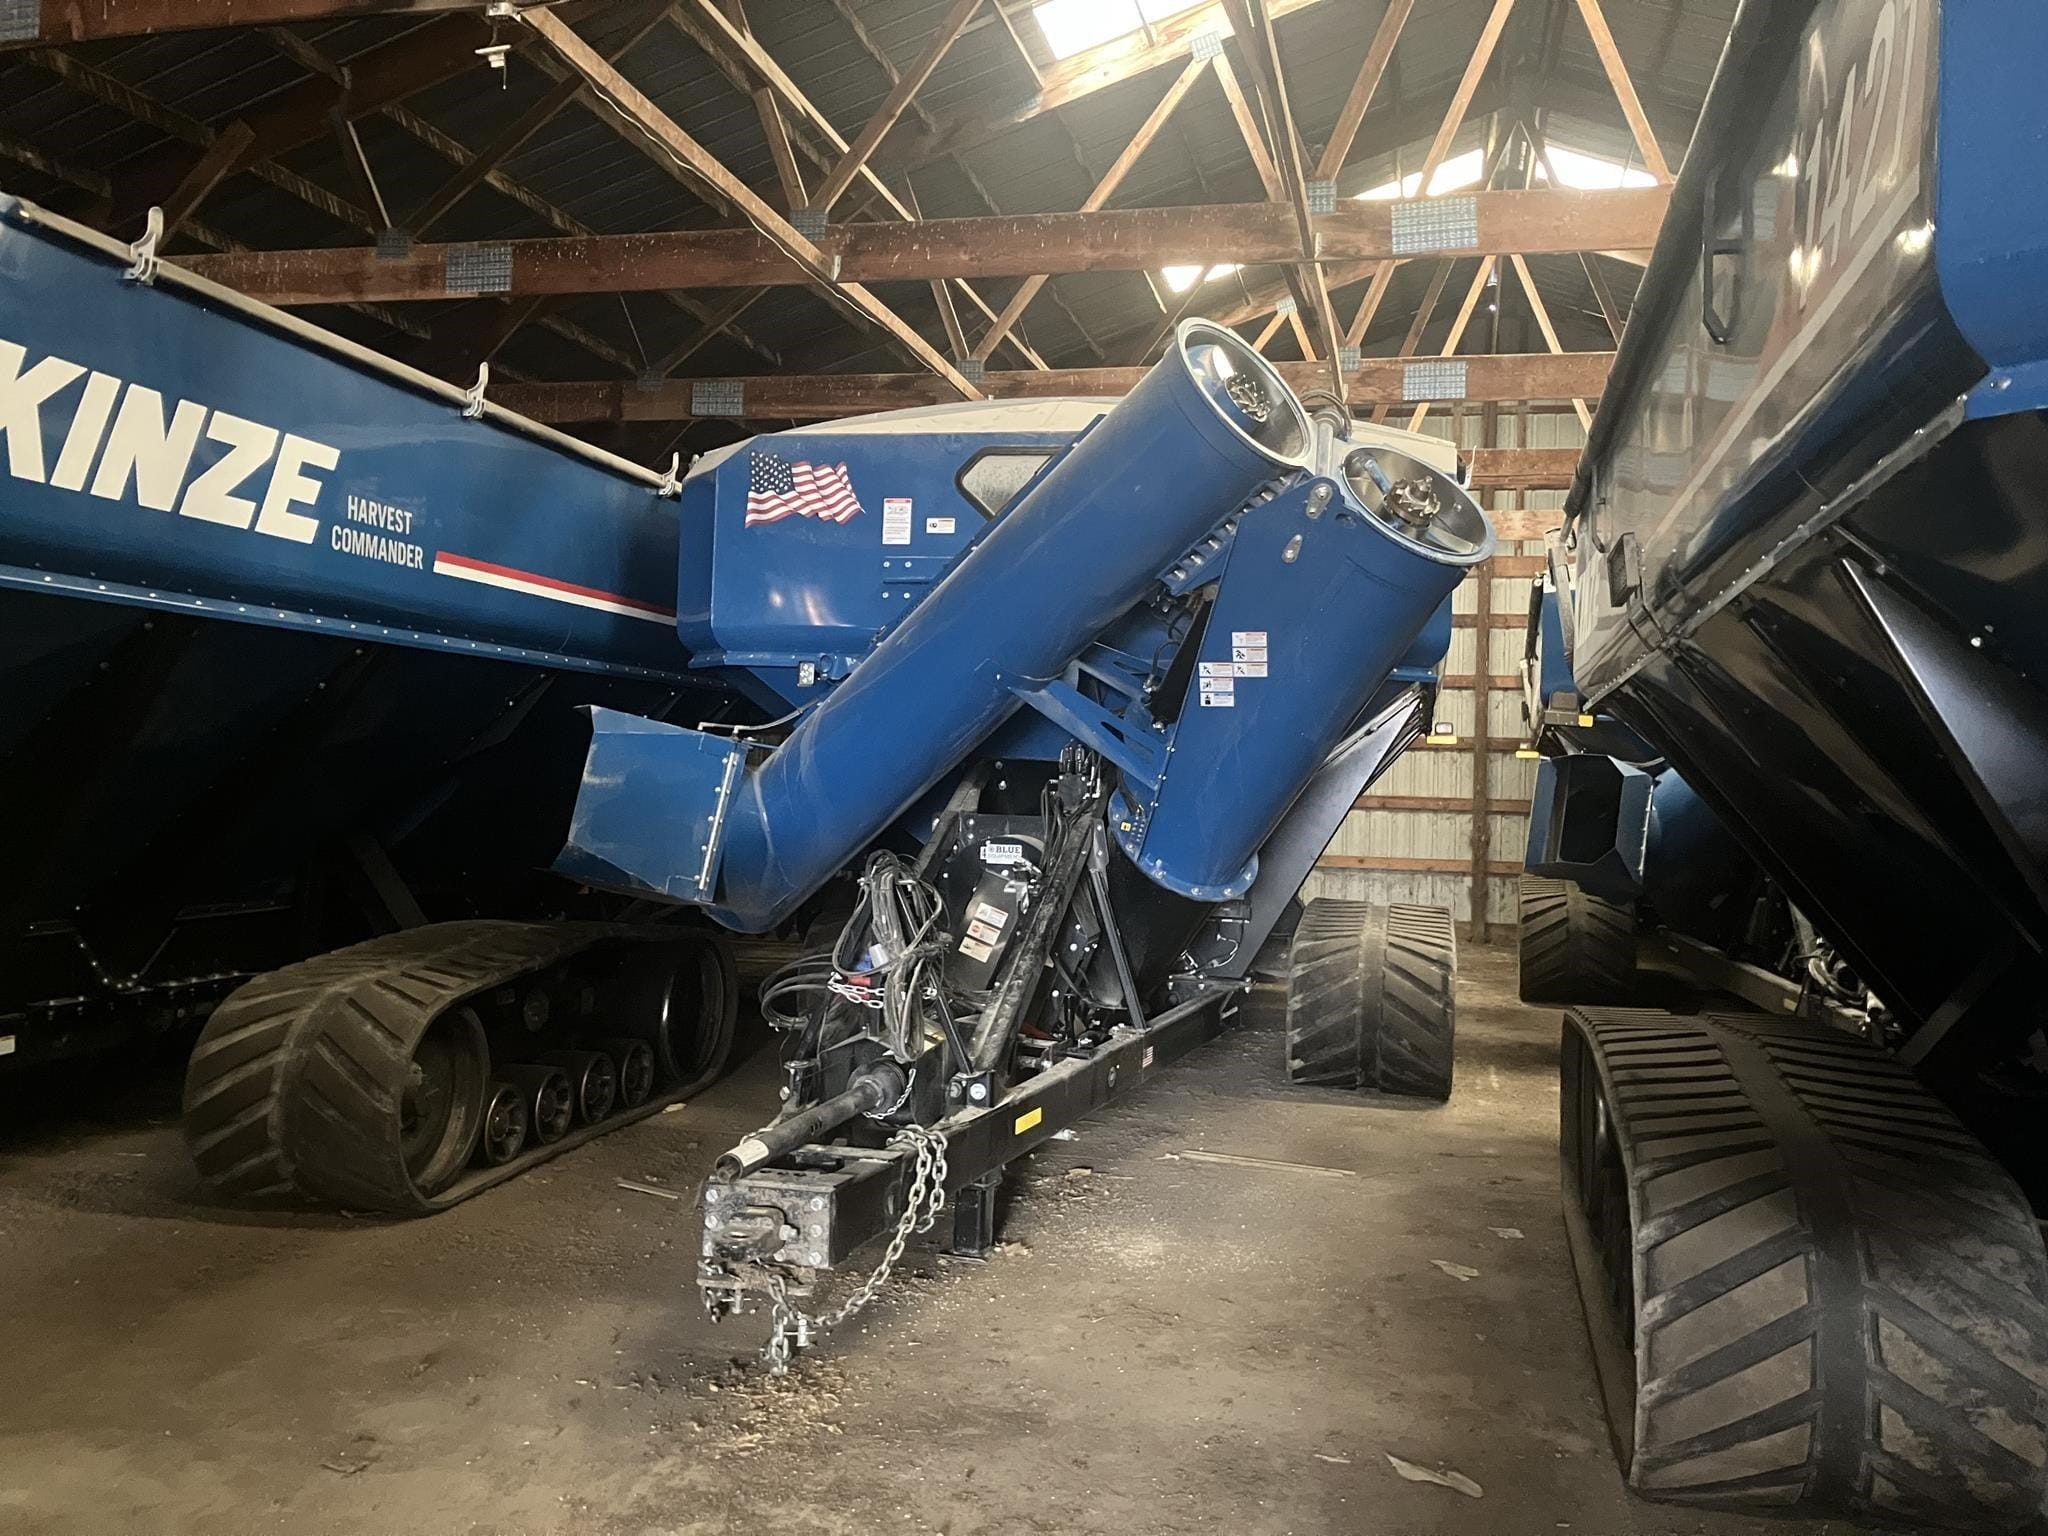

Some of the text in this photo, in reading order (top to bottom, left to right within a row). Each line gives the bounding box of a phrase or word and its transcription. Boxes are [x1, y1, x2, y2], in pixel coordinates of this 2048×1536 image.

[0, 338, 341, 544] KINZE
[347, 495, 413, 535] HARVEST
[331, 525, 424, 570] COMMANDER
[995, 845, 1021, 854] BLUE
